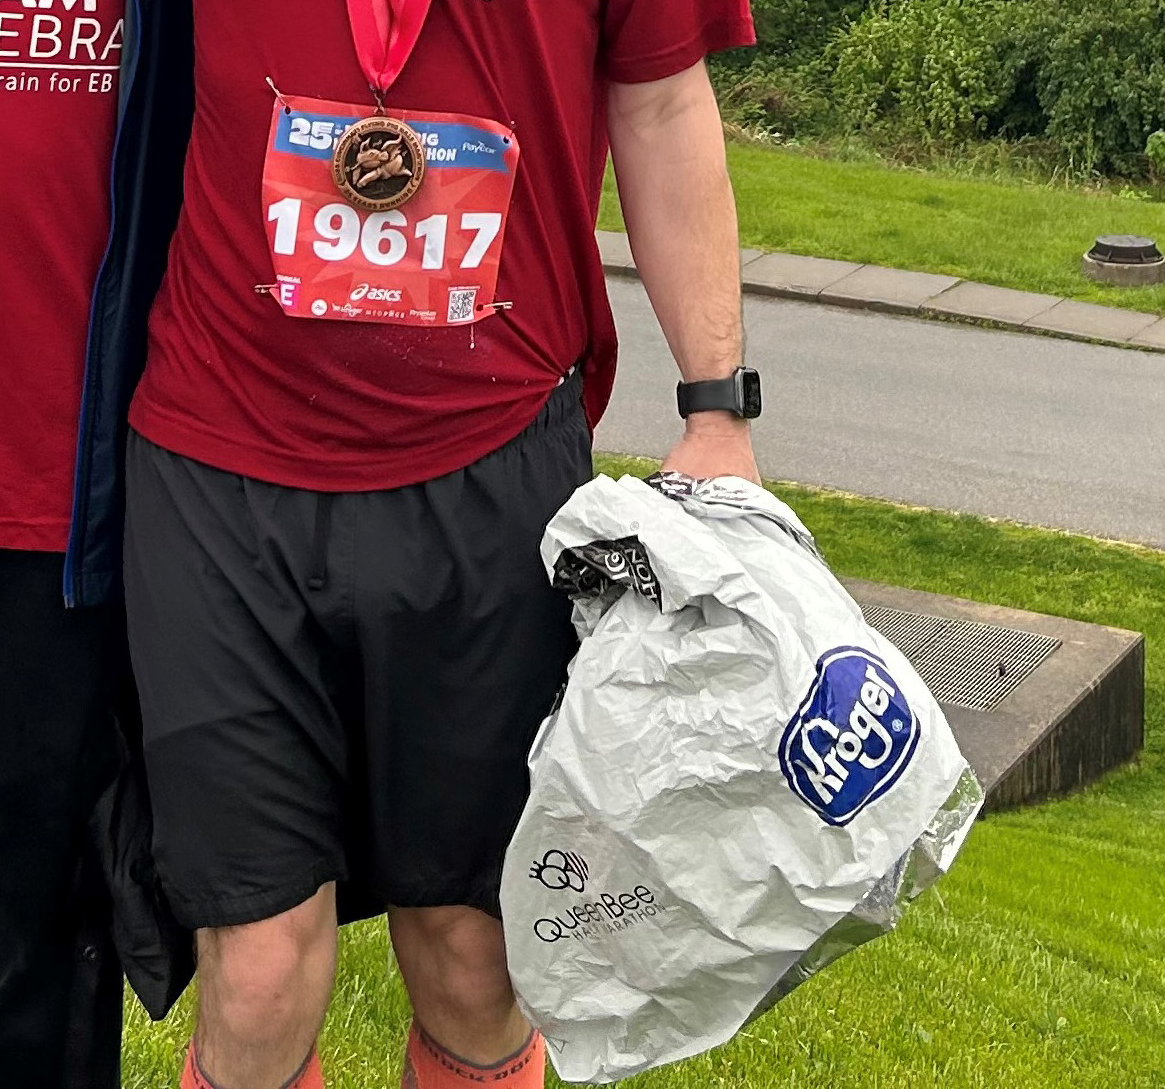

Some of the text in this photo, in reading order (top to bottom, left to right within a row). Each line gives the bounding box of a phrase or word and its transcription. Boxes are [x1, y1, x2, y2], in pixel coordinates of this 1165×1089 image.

[49, 72, 81, 92] for
[88, 72, 113, 93] EB
[289, 118, 334, 150] 25
[268, 198, 502, 270] 19617
[280, 284, 295, 306] E
[794, 664, 895, 805] Kroger
